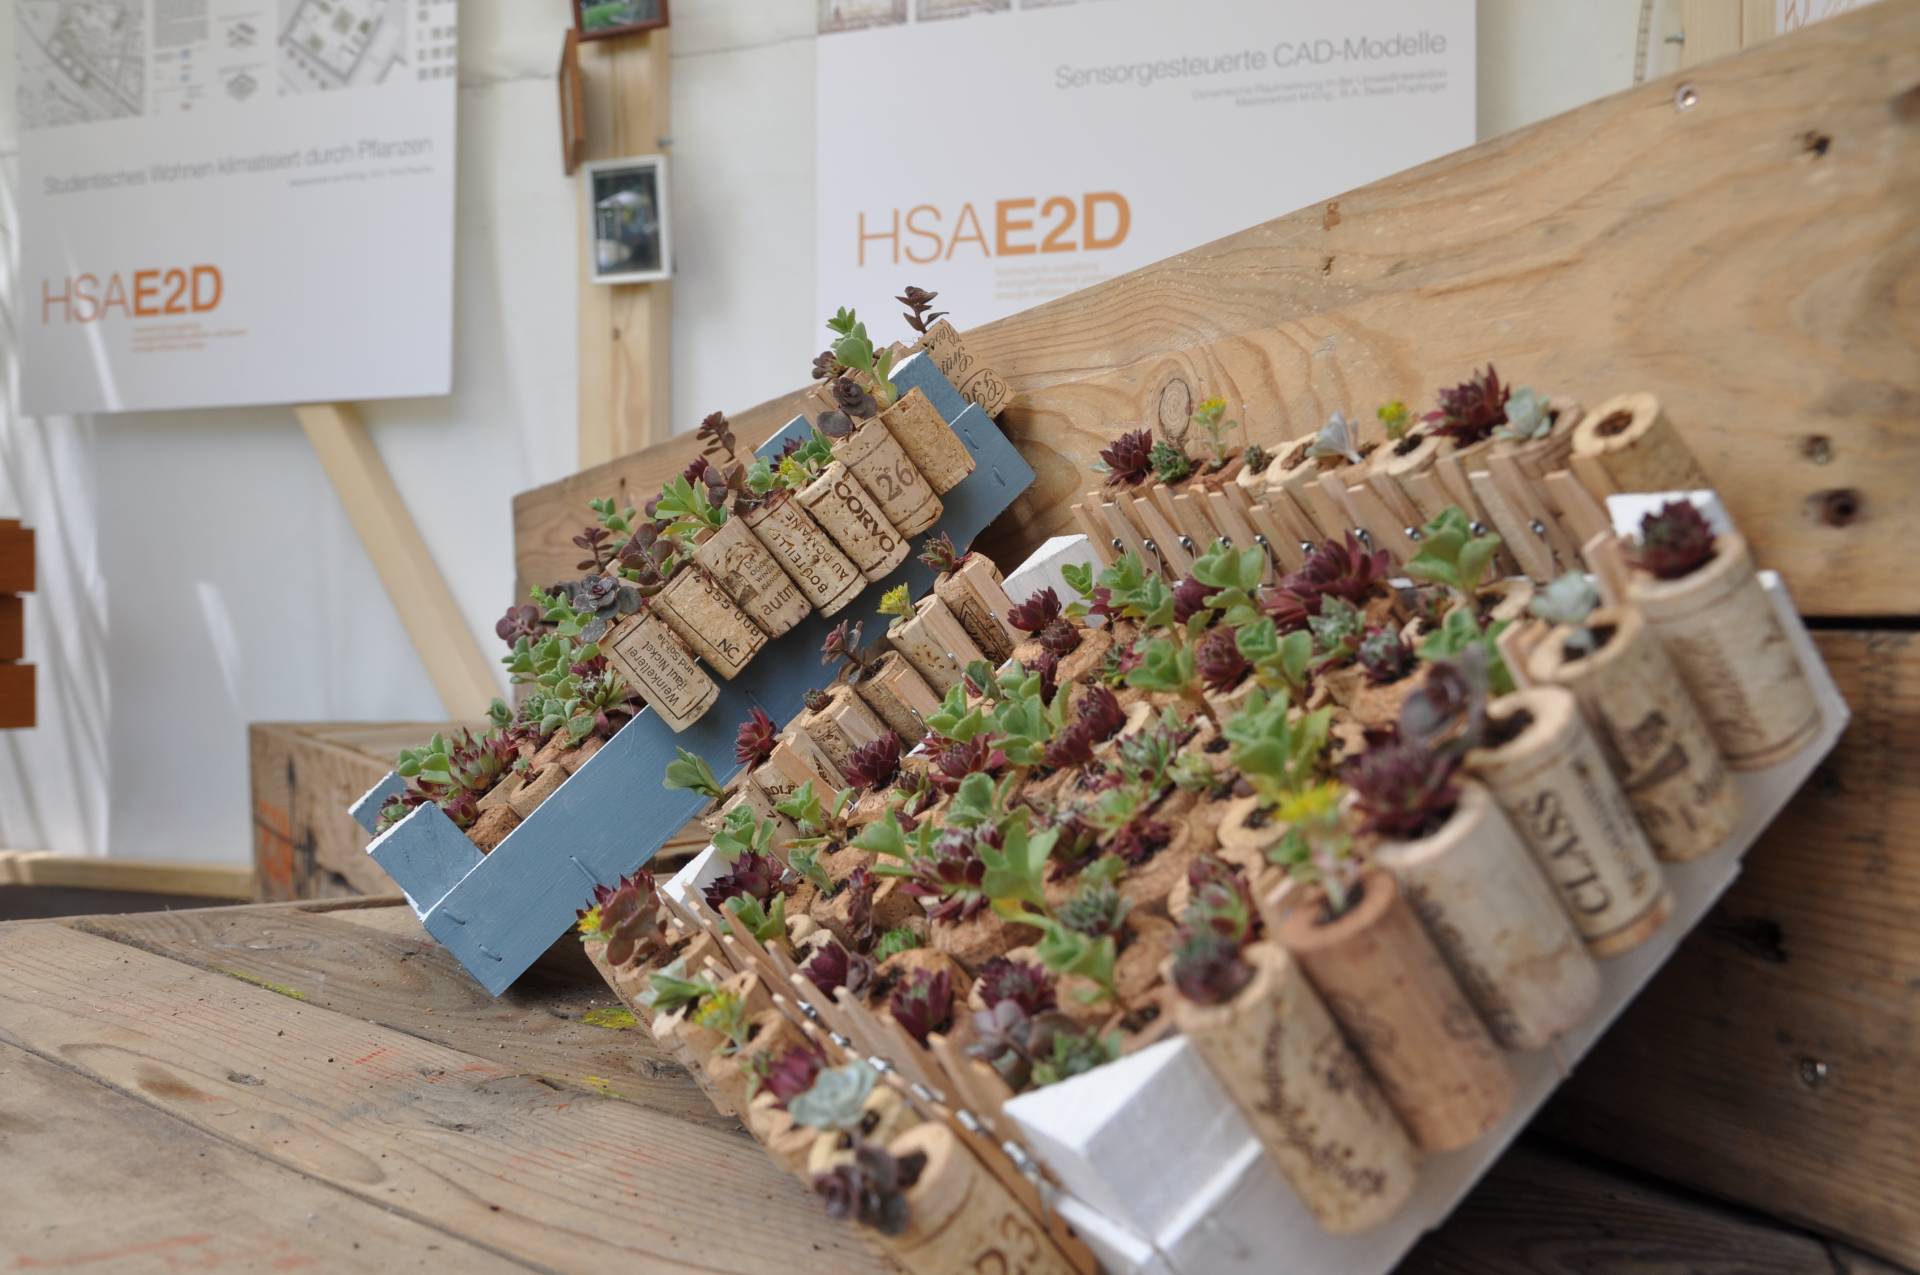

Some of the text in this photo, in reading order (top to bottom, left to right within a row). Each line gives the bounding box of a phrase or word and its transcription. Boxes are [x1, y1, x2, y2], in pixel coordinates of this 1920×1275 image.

[1054, 46, 1267, 91] Sensorgesteuerte
[1273, 31, 1448, 69] CAD-Modelle
[149, 154, 215, 184] Wohnen
[303, 141, 355, 168] durch
[356, 135, 434, 161] Pflanzen
[857, 190, 1132, 268] HSAE2D
[41, 264, 224, 325] HSAE2D
[834, 480, 896, 555] CORVO
[831, 561, 849, 579] AU
[625, 645, 679, 705] Weinkellerei
[641, 640, 669, 670] Nickel
[677, 657, 694, 674] und
[716, 637, 740, 659] NC
[1529, 789, 1612, 916] CLASS
